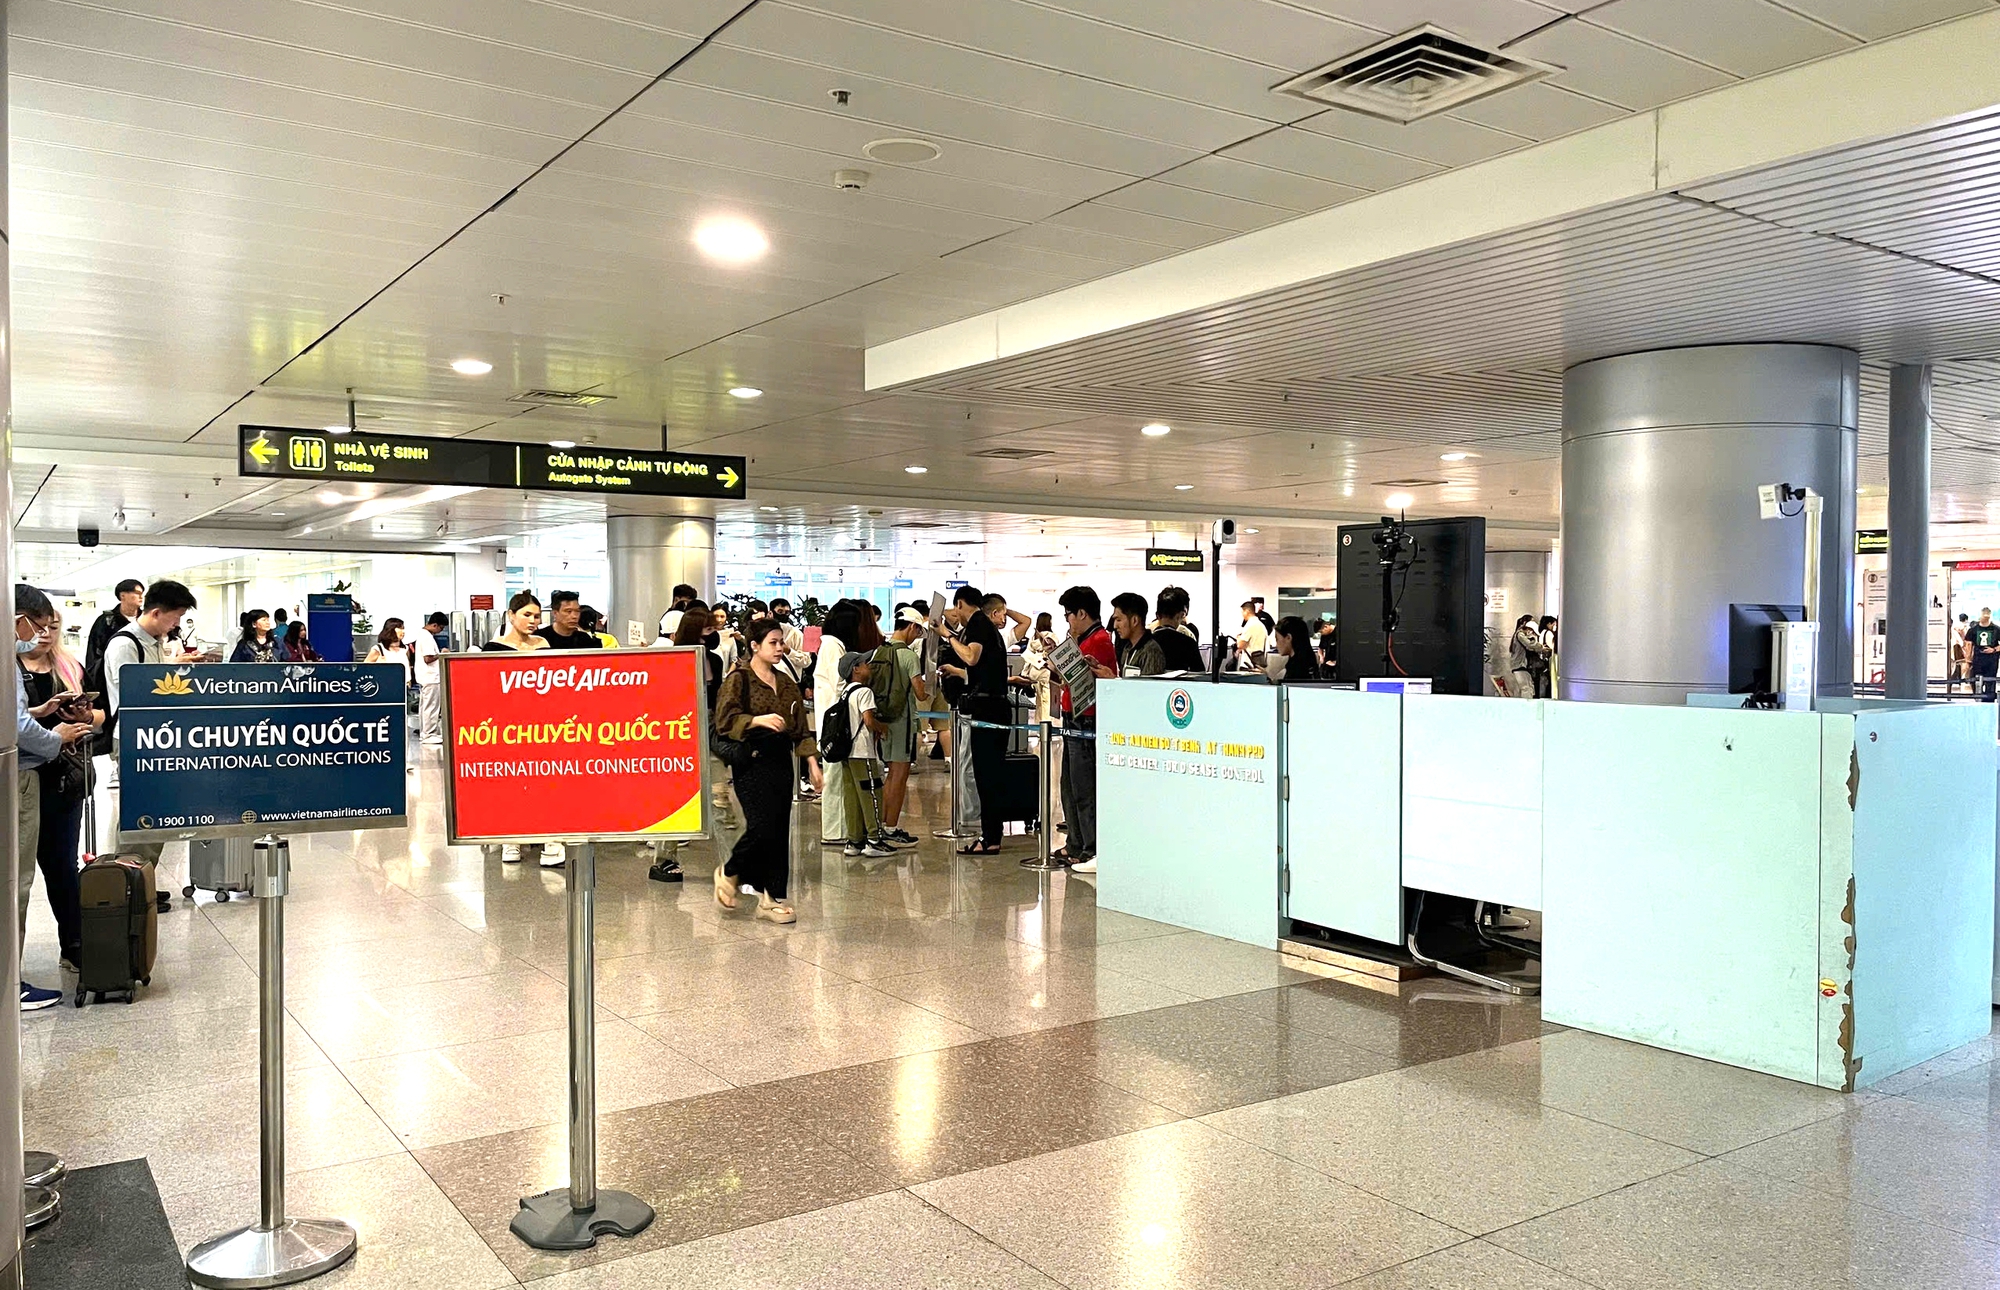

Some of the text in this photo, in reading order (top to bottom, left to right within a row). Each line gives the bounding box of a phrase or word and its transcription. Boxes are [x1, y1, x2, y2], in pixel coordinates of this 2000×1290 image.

[334, 440, 429, 461] NHÀ VỆ SINH
[334, 460, 375, 474] Toilets
[547, 452, 709, 477] CỬA NHẬP CẢNH TỰ ĐỘNG
[548, 471, 631, 488] Autogate System
[562, 561, 568, 570] 7
[136, 715, 391, 750] NỐI CHUYẾN QUỐC TẾ
[458, 711, 693, 746] NỐI CHUYẾN QUỐC TẾ
[136, 750, 391, 773] INTERNATIONAL CONNECTIONS
[460, 756, 694, 778] INTERNATIONAL CONNECTIONS
[1180, 762, 1218, 779] DSEASE
[158, 814, 215, 827] 1900 1100
[261, 806, 392, 822] www.vietnamairlines.com
